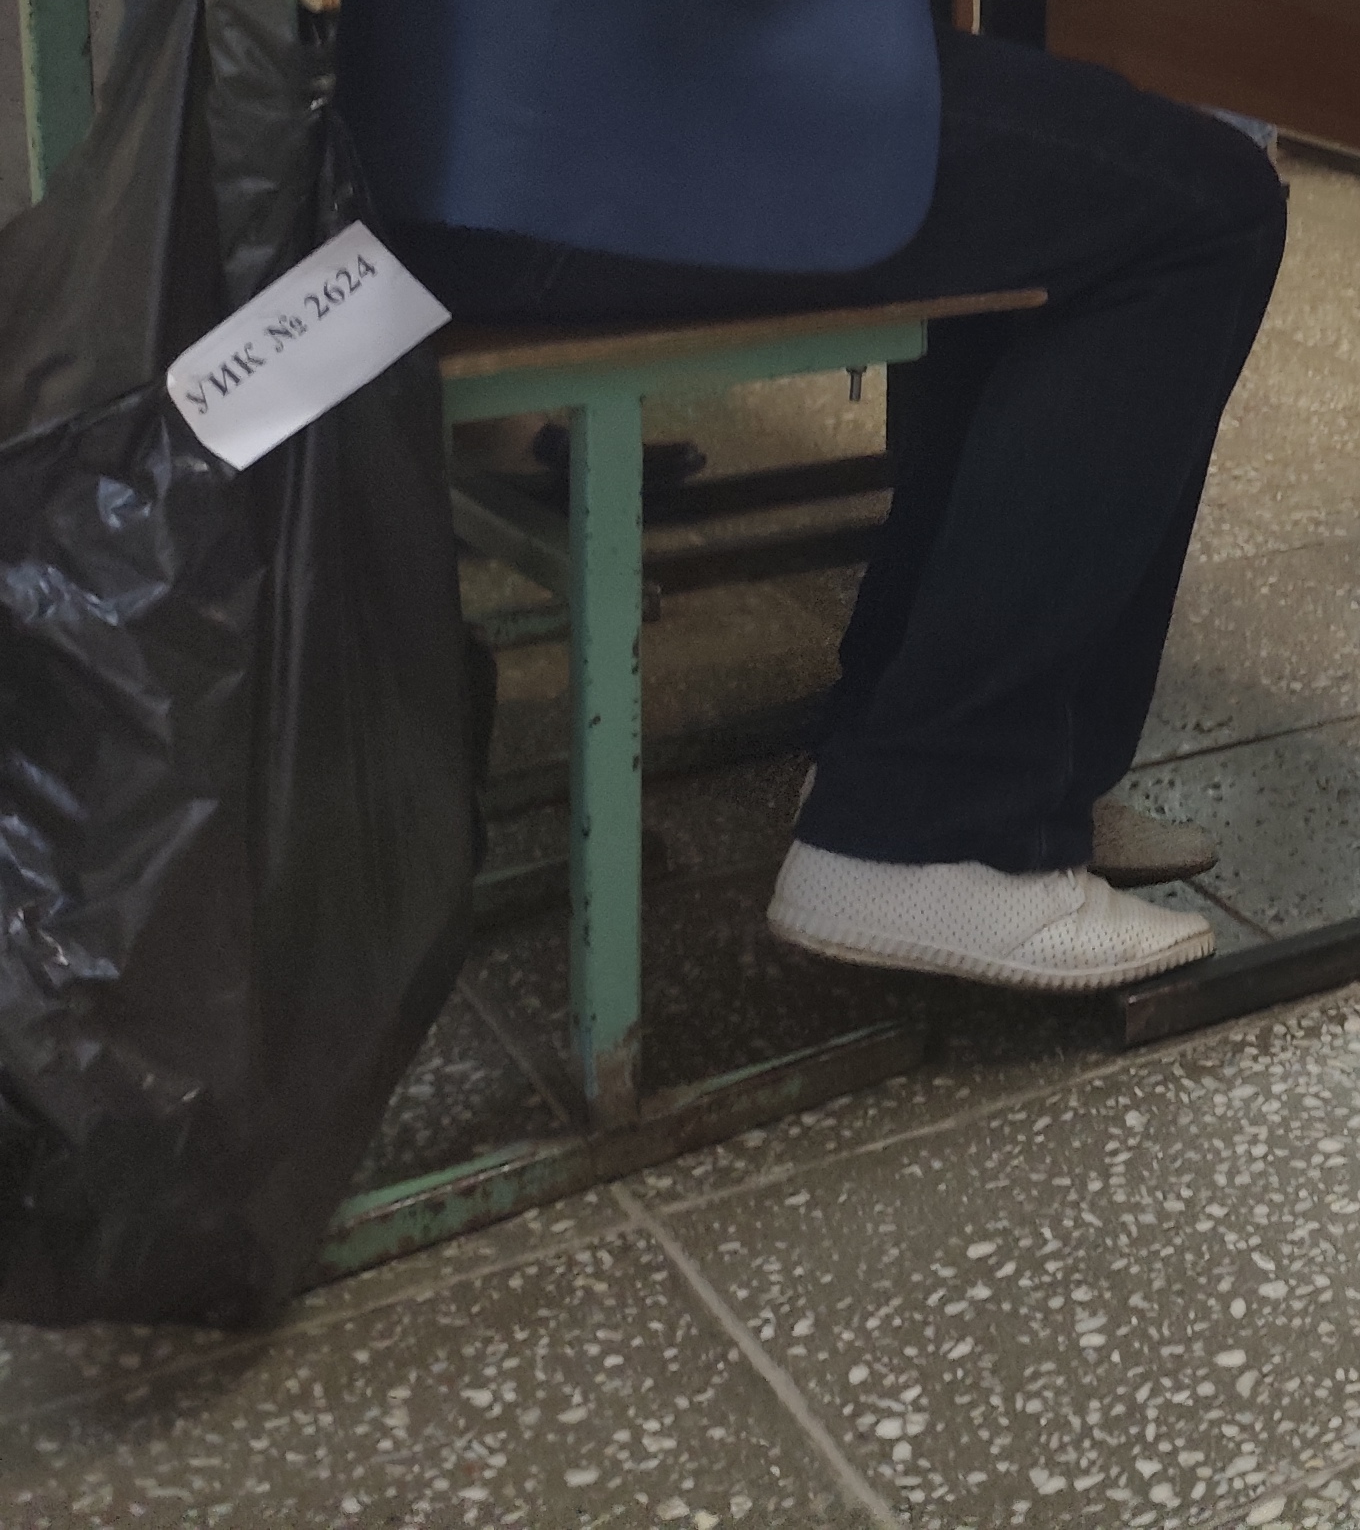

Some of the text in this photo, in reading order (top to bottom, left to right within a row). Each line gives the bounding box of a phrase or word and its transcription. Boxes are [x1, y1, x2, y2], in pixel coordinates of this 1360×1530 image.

[186, 254, 378, 415] УИК № 2624
